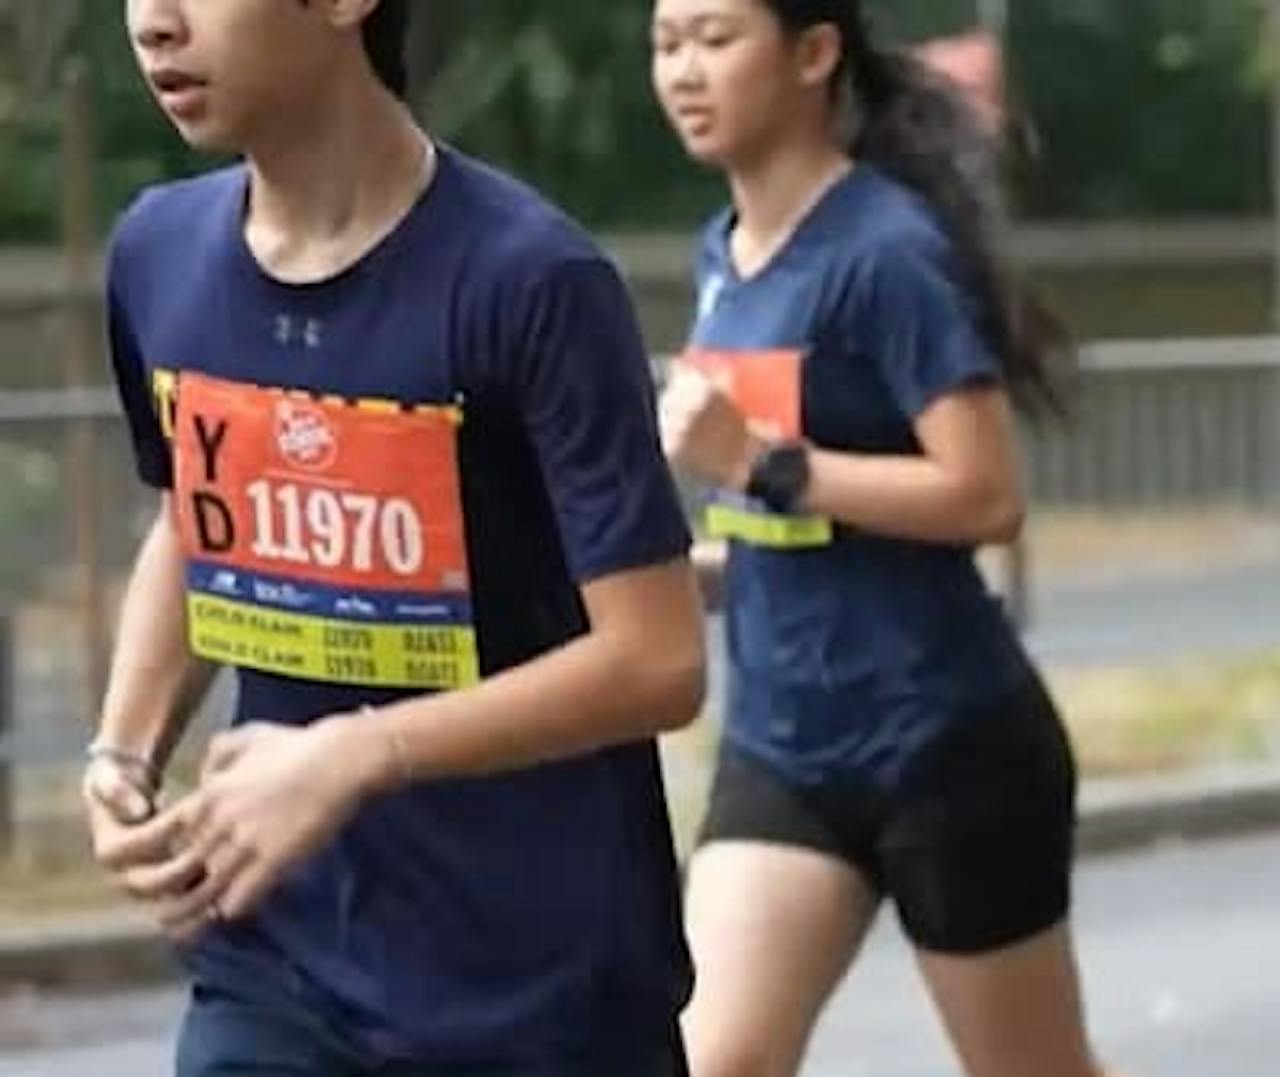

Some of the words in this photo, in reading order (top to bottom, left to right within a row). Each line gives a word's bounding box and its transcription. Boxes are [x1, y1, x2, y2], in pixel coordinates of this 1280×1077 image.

[193, 414, 230, 480] Y
[191, 492, 234, 552] D
[246, 479, 424, 575] 11970
